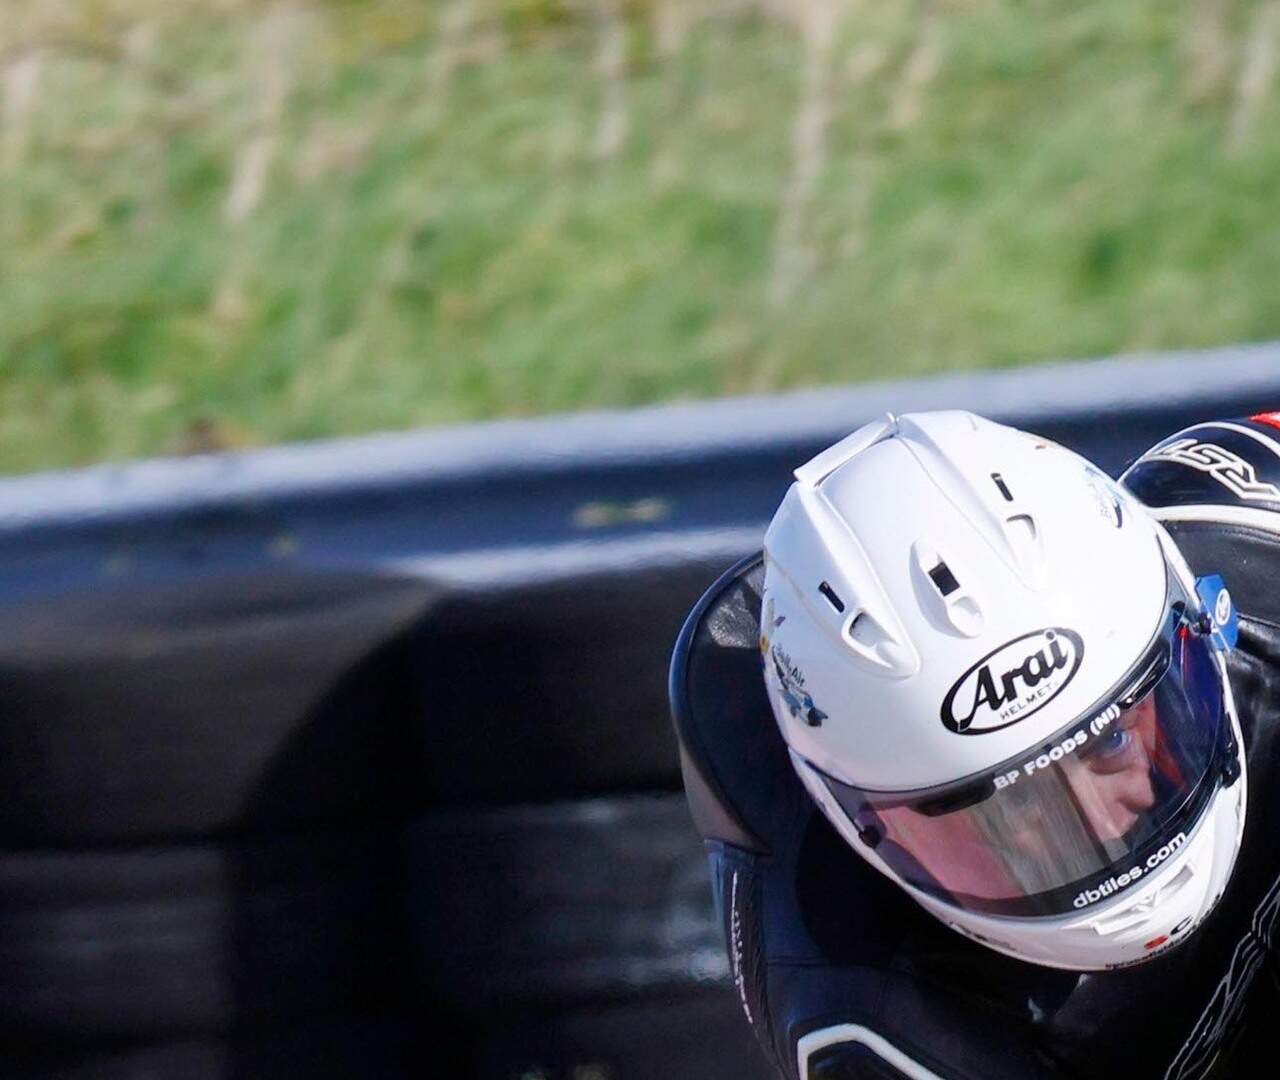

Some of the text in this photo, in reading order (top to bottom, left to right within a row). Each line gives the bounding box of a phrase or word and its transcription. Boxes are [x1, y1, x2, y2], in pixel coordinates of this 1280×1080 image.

[959, 630, 1069, 732] Arai
[1000, 682, 1054, 721] HELMET
[993, 702, 1121, 789] BP FOODS (NI)
[1073, 831, 1187, 908] dbtiles.com
